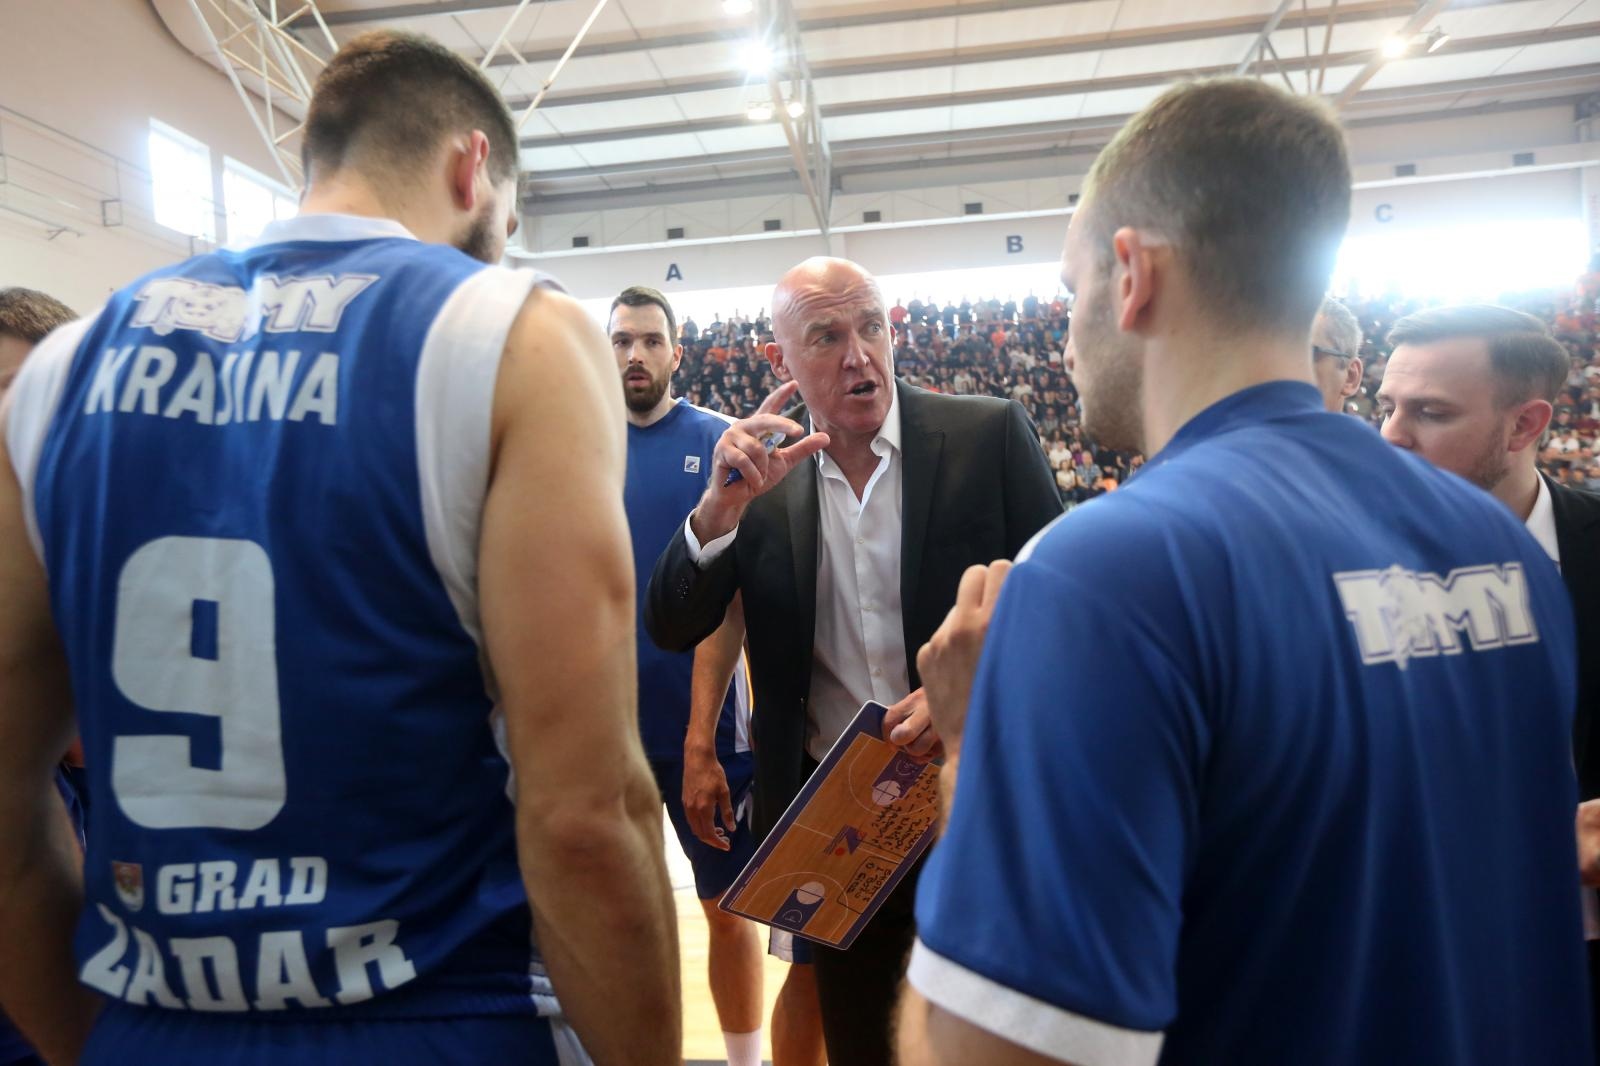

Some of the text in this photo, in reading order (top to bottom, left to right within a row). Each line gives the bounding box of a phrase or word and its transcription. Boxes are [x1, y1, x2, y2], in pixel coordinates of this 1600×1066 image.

[1006, 235, 1024, 254] B
[1375, 203, 1393, 223] C
[665, 263, 683, 281] A
[129, 273, 380, 343] TMY
[85, 344, 340, 425] KRAJINA
[1333, 562, 1538, 670] TMY
[111, 536, 287, 830] 9
[156, 856, 328, 915] GRAD
[79, 902, 417, 1012] ZADAR
